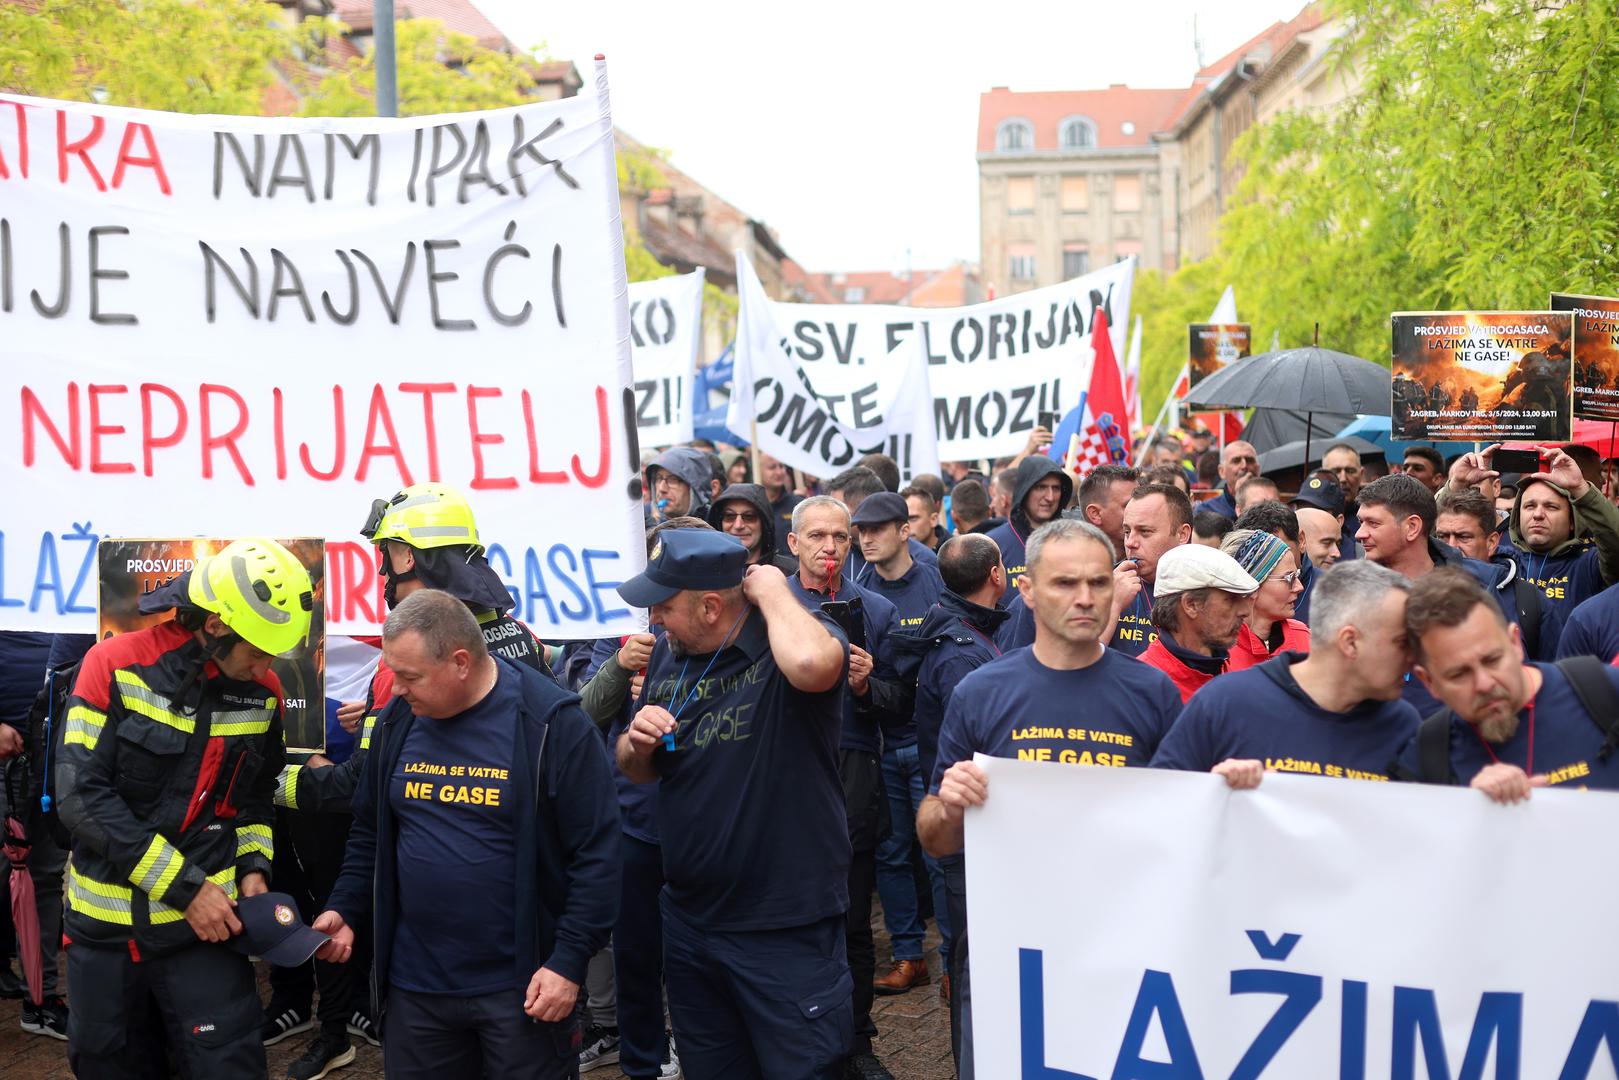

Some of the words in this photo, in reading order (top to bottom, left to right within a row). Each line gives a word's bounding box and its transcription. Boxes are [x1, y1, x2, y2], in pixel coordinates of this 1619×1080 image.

[0, 101, 172, 196] TRA
[212, 131, 382, 207] NAM
[407, 113, 582, 207] IPAK
[198, 219, 567, 330] NAJVEĆI
[1414, 326, 1466, 336] PROSVJED
[1610, 335, 1619, 345] N
[794, 320, 865, 366] SV.
[1428, 337, 1476, 350] LAŽIMA
[1478, 339, 1493, 349] SE
[1496, 338, 1538, 349] VATRE
[1455, 351, 1471, 362] NE
[1474, 351, 1510, 362] GASE!
[1595, 387, 1619, 397] MARKO
[1410, 410, 1438, 419] ZAGREB,
[1439, 410, 1470, 418] MARKOV
[1488, 410, 1521, 419] 3/5/2024,
[1541, 410, 1557, 418] SATI
[20, 381, 643, 500] NEPRIJATELJ!
[0, 521, 97, 617] LAŽ
[126, 559, 195, 573] PROSVJED
[286, 698, 306, 709] SATI
[694, 703, 752, 749] GASE
[1012, 726, 1064, 740] LAŽIMA
[1067, 728, 1086, 740] SE
[1089, 730, 1134, 747] VATRE
[404, 762, 447, 776] LAŽIMA
[449, 766, 466, 776] SE
[468, 766, 509, 780] VATRE
[1265, 758, 1322, 774] LAŽIMA
[1324, 764, 1343, 778] SE
[404, 781, 434, 800] NE
[439, 784, 500, 807] GASE
[1018, 929, 1619, 1080] LAŽIMA
